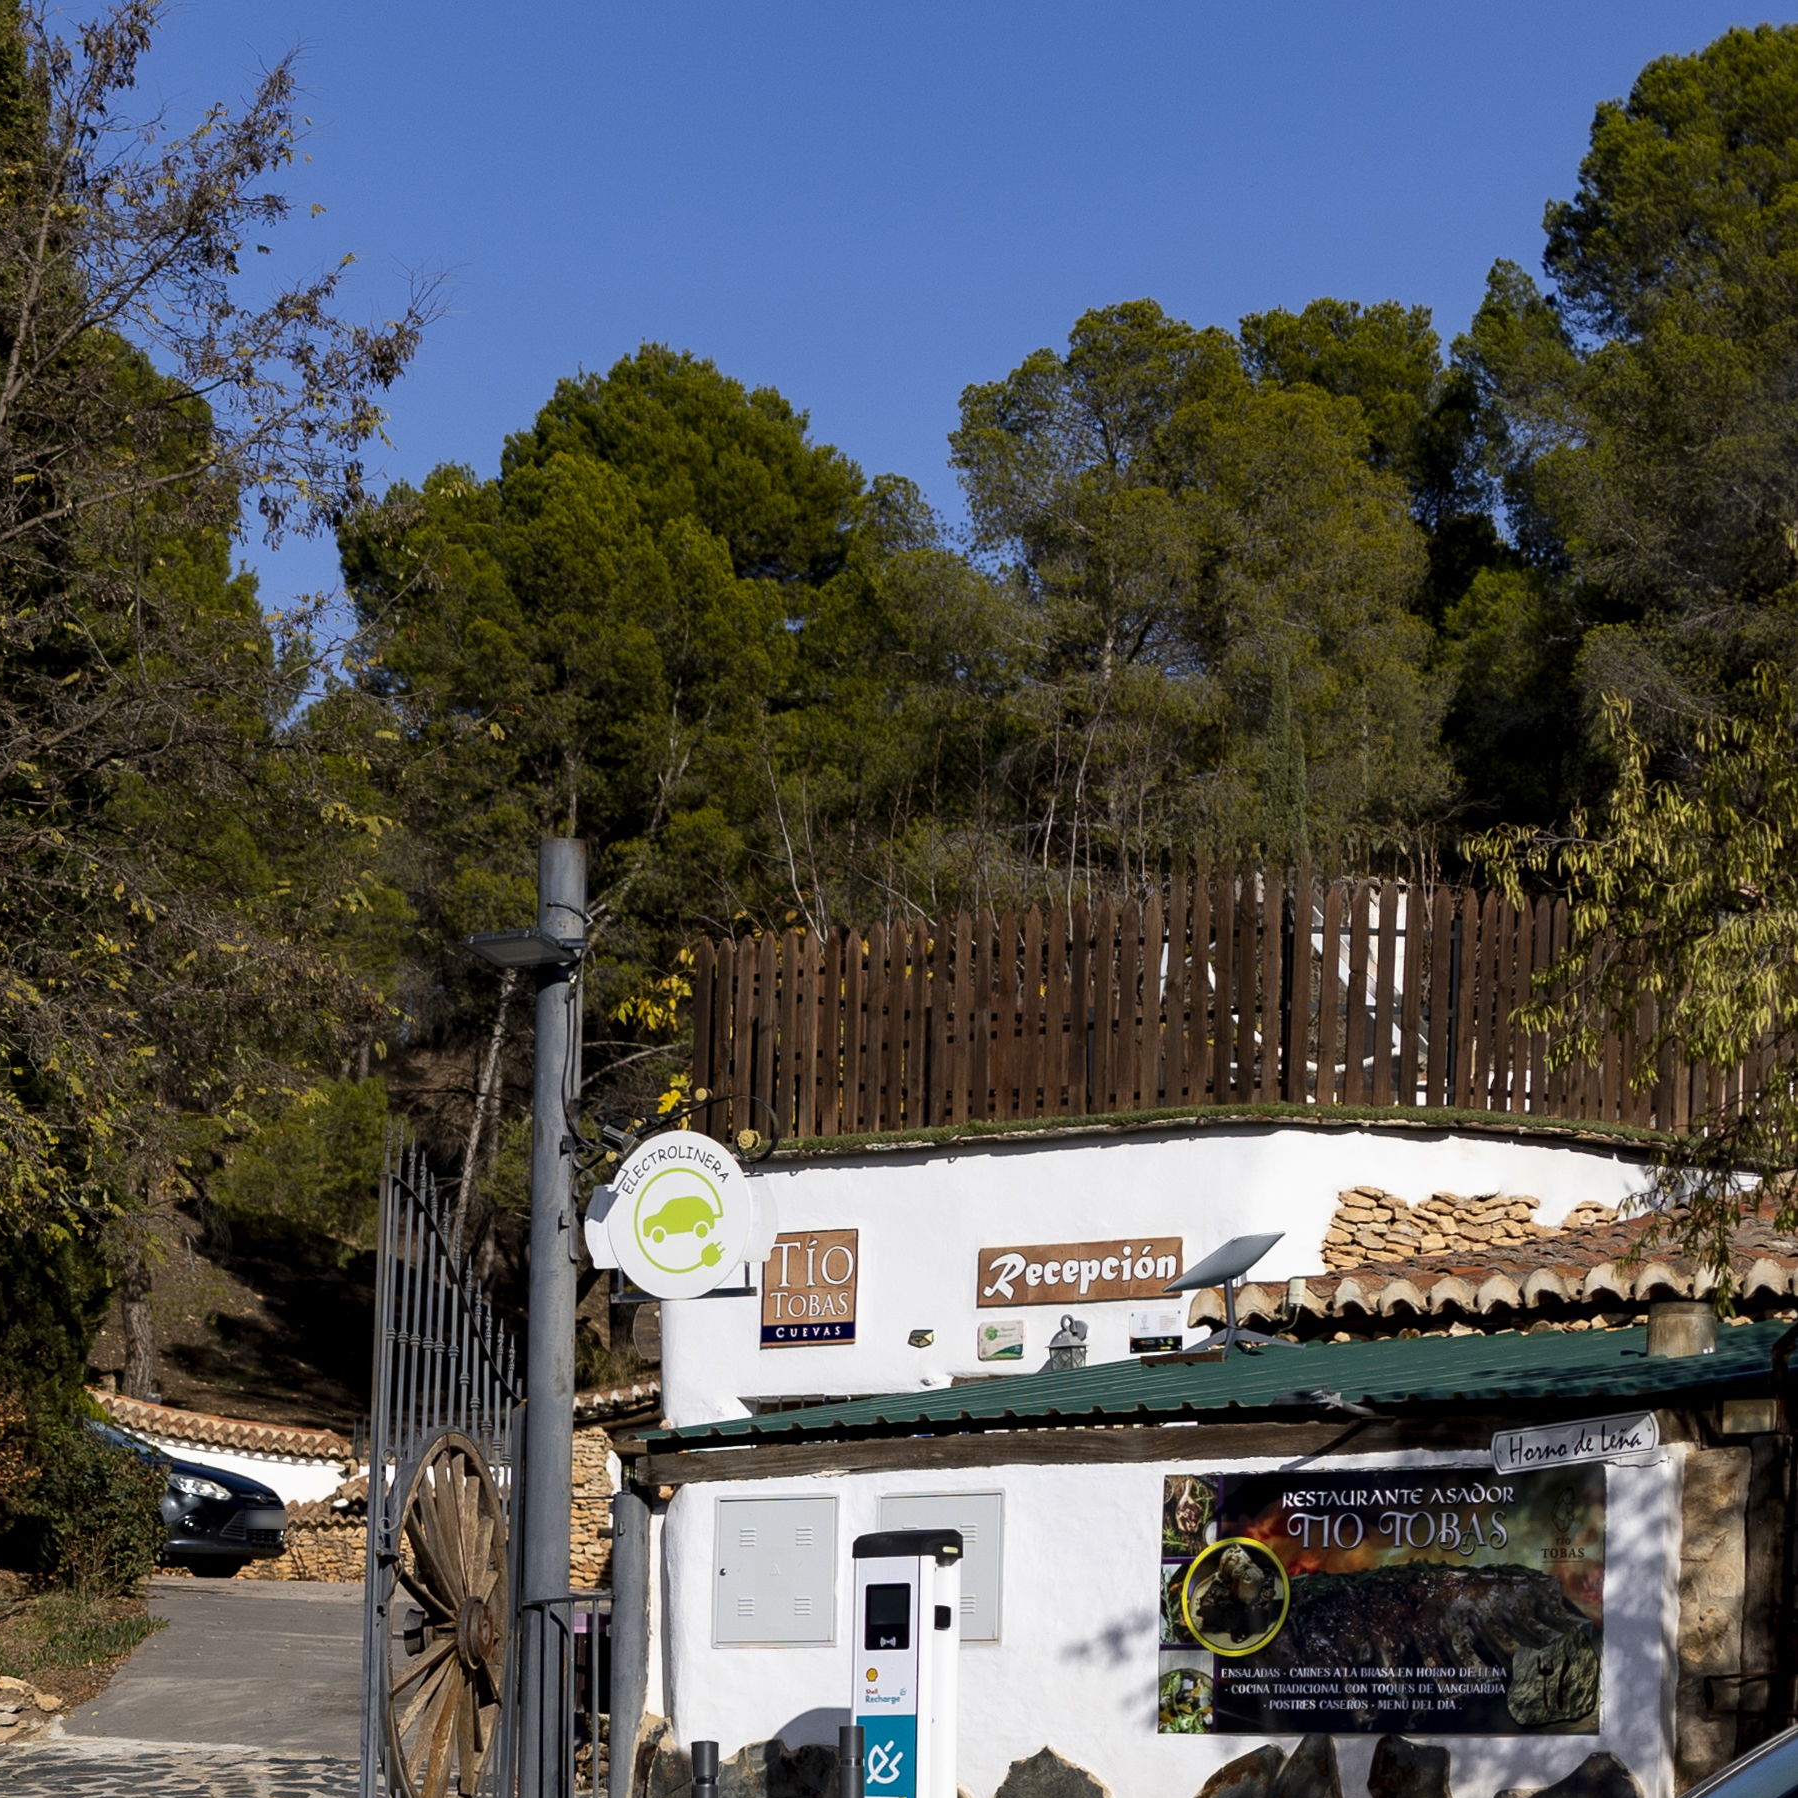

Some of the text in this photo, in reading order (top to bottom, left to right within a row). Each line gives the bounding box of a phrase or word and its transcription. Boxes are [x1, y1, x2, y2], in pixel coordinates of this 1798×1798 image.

[621, 1145, 730, 1195] ELECTROLINERA
[771, 1239, 854, 1288] TÍO
[982, 1245, 1177, 1300] Recepción
[769, 1291, 849, 1319] TOBAS
[776, 1326, 841, 1338] CUEVAS
[1509, 1435, 1568, 1465] Horno
[1573, 1428, 1594, 1456] de
[1282, 1482, 1515, 1509] RESTAURANTE ASADOR
[1378, 1511, 1509, 1556] TOBAS
[1540, 1547, 1585, 1558] TOBAS
[1221, 1667, 1280, 1678] ENSALADAS
[1289, 1667, 1331, 1678] CARNES
[1333, 1667, 1342, 1678] A
[1344, 1667, 1358, 1678] LA
[1360, 1667, 1395, 1678] BRASA
[1398, 1667, 1414, 1678] EN
[1416, 1667, 1456, 1678] HORNO
[1459, 1667, 1475, 1678] DE
[865, 1694, 901, 1705] Recharge
[1231, 1683, 1506, 1696] COCINA TRADICIONAL CON TOQUES DE VANGUARDIA
[1269, 1699, 1317, 1710] POSTRES
[1318, 1699, 1369, 1710] CASEROS
[1412, 1699, 1435, 1710] DEL
